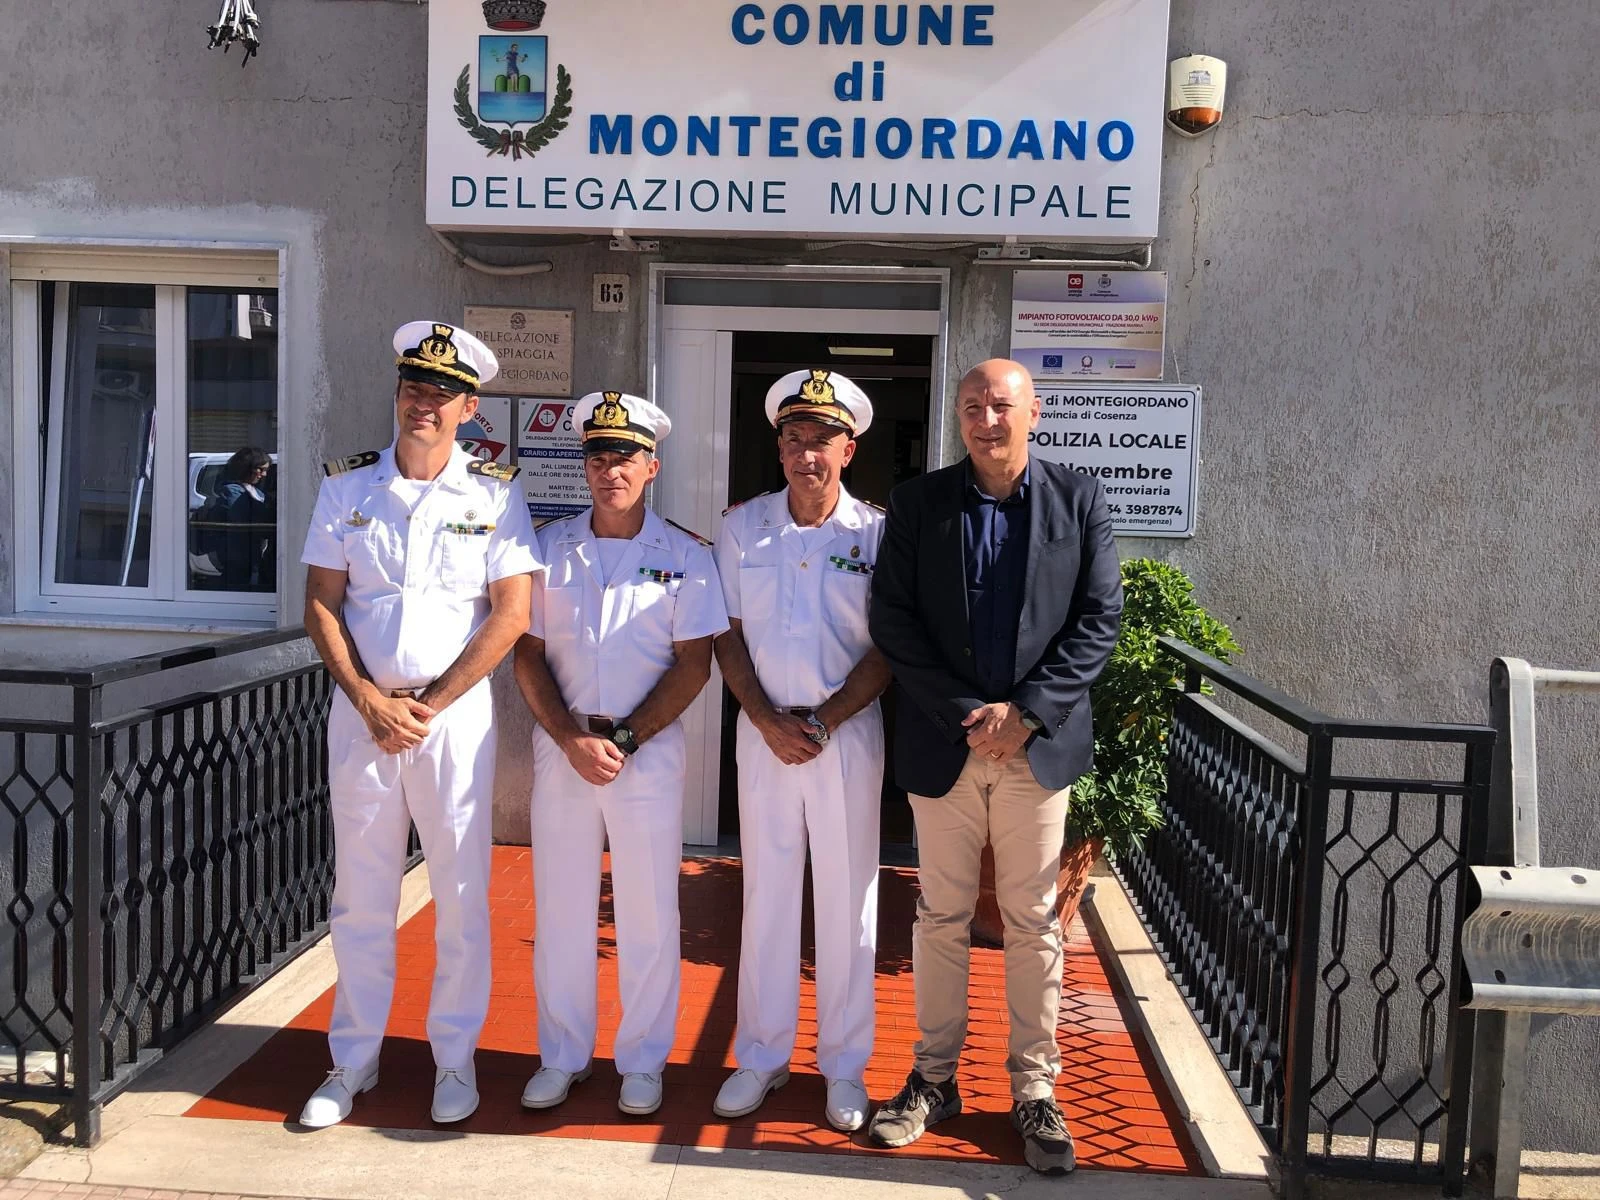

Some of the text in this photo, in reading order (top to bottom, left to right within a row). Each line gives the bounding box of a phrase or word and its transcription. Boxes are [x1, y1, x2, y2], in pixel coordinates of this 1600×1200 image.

[731, 3, 995, 46] COMUNE
[834, 61, 884, 102] di
[589, 114, 1135, 162] MONTEGIORDANO
[451, 176, 1132, 219] DELEGAZIONE MUNICIPALE
[1018, 313, 1055, 321] IMPIANTO
[1056, 313, 1111, 321] FOTOVOLTAICO
[1142, 314, 1159, 323] kWp
[475, 330, 560, 344] DELEGAZIONE
[497, 347, 555, 360] SPIAGGIA
[1046, 395, 1189, 408] di MONTEGIORDANO
[474, 411, 494, 433] ORTO
[1081, 411, 1091, 420] di
[1094, 411, 1137, 420] Cosenza
[1027, 432, 1187, 449] POLIZIA LOCALE
[1125, 504, 1183, 516] 3987874
[1129, 517, 1172, 526] emergenze)
